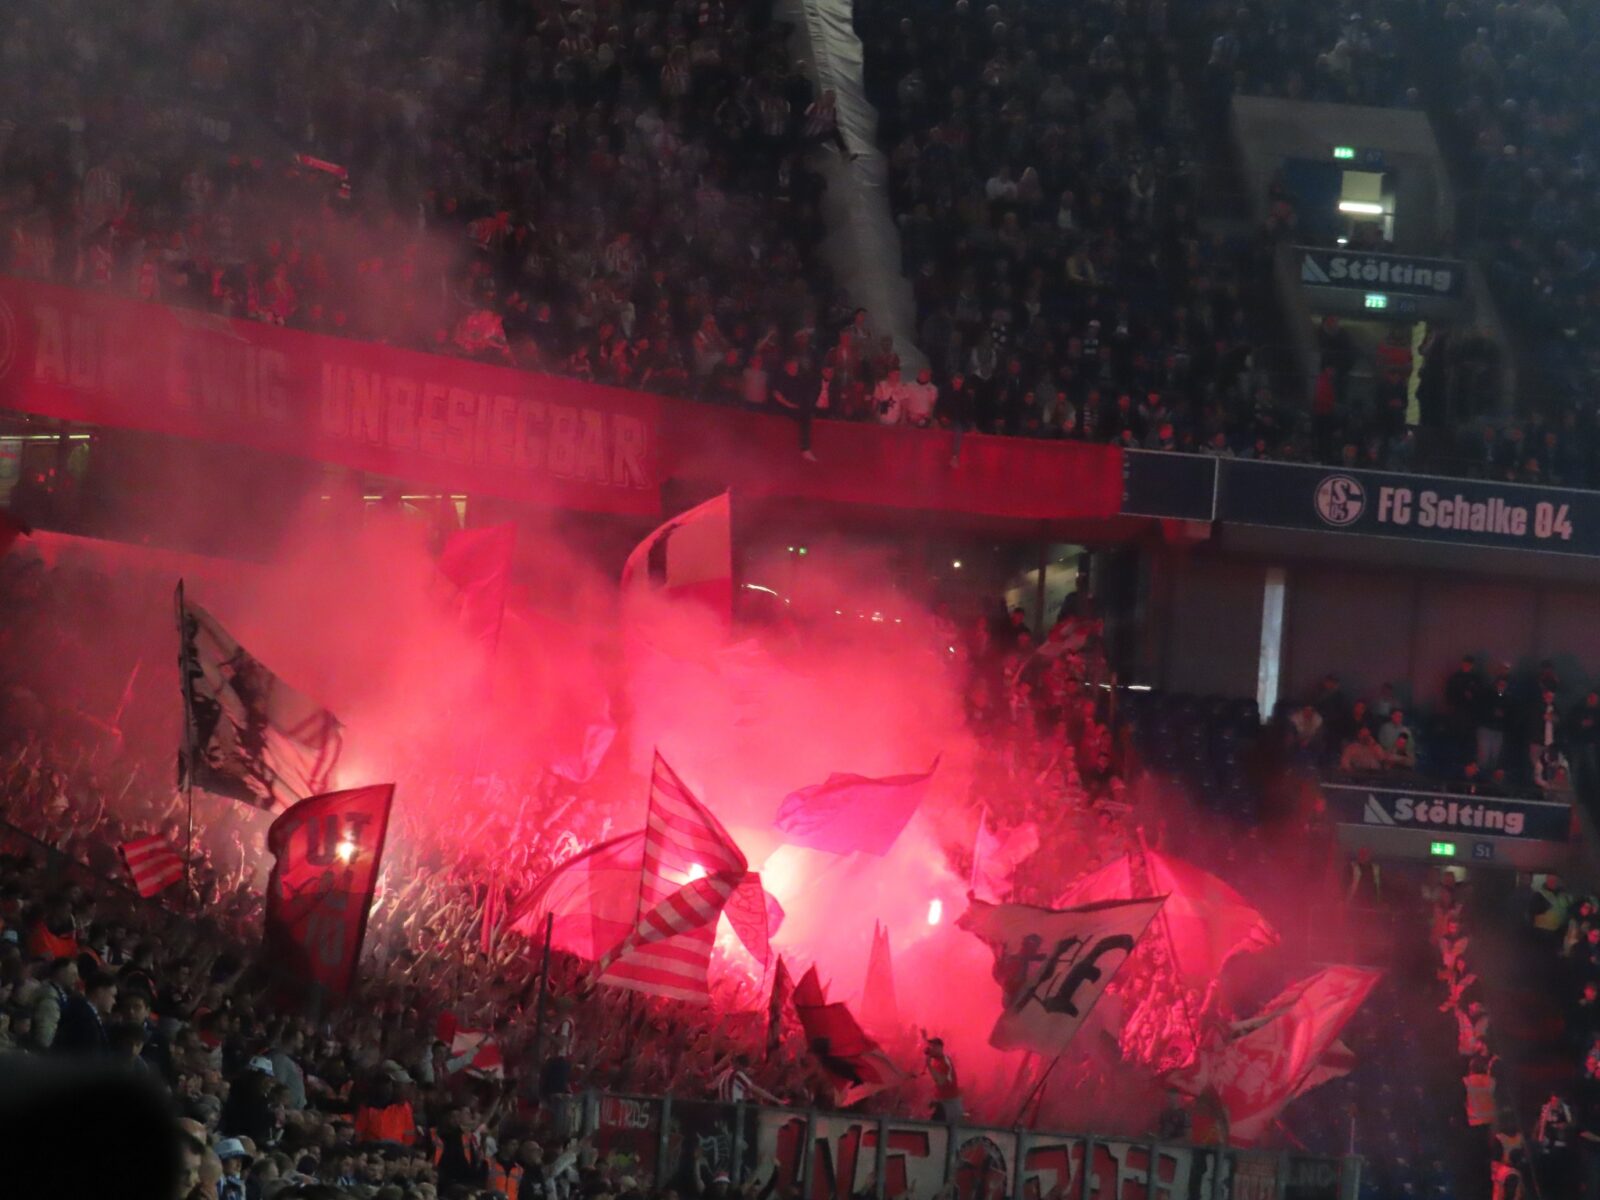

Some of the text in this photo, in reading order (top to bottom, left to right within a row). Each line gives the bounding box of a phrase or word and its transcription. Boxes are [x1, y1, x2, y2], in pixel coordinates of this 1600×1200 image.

[1329, 257, 1451, 292] Stölting
[320, 360, 653, 490] UNBESIEGBAR
[1377, 486, 1573, 540] FC Schalke 04
[1393, 797, 1525, 835] Stölting
